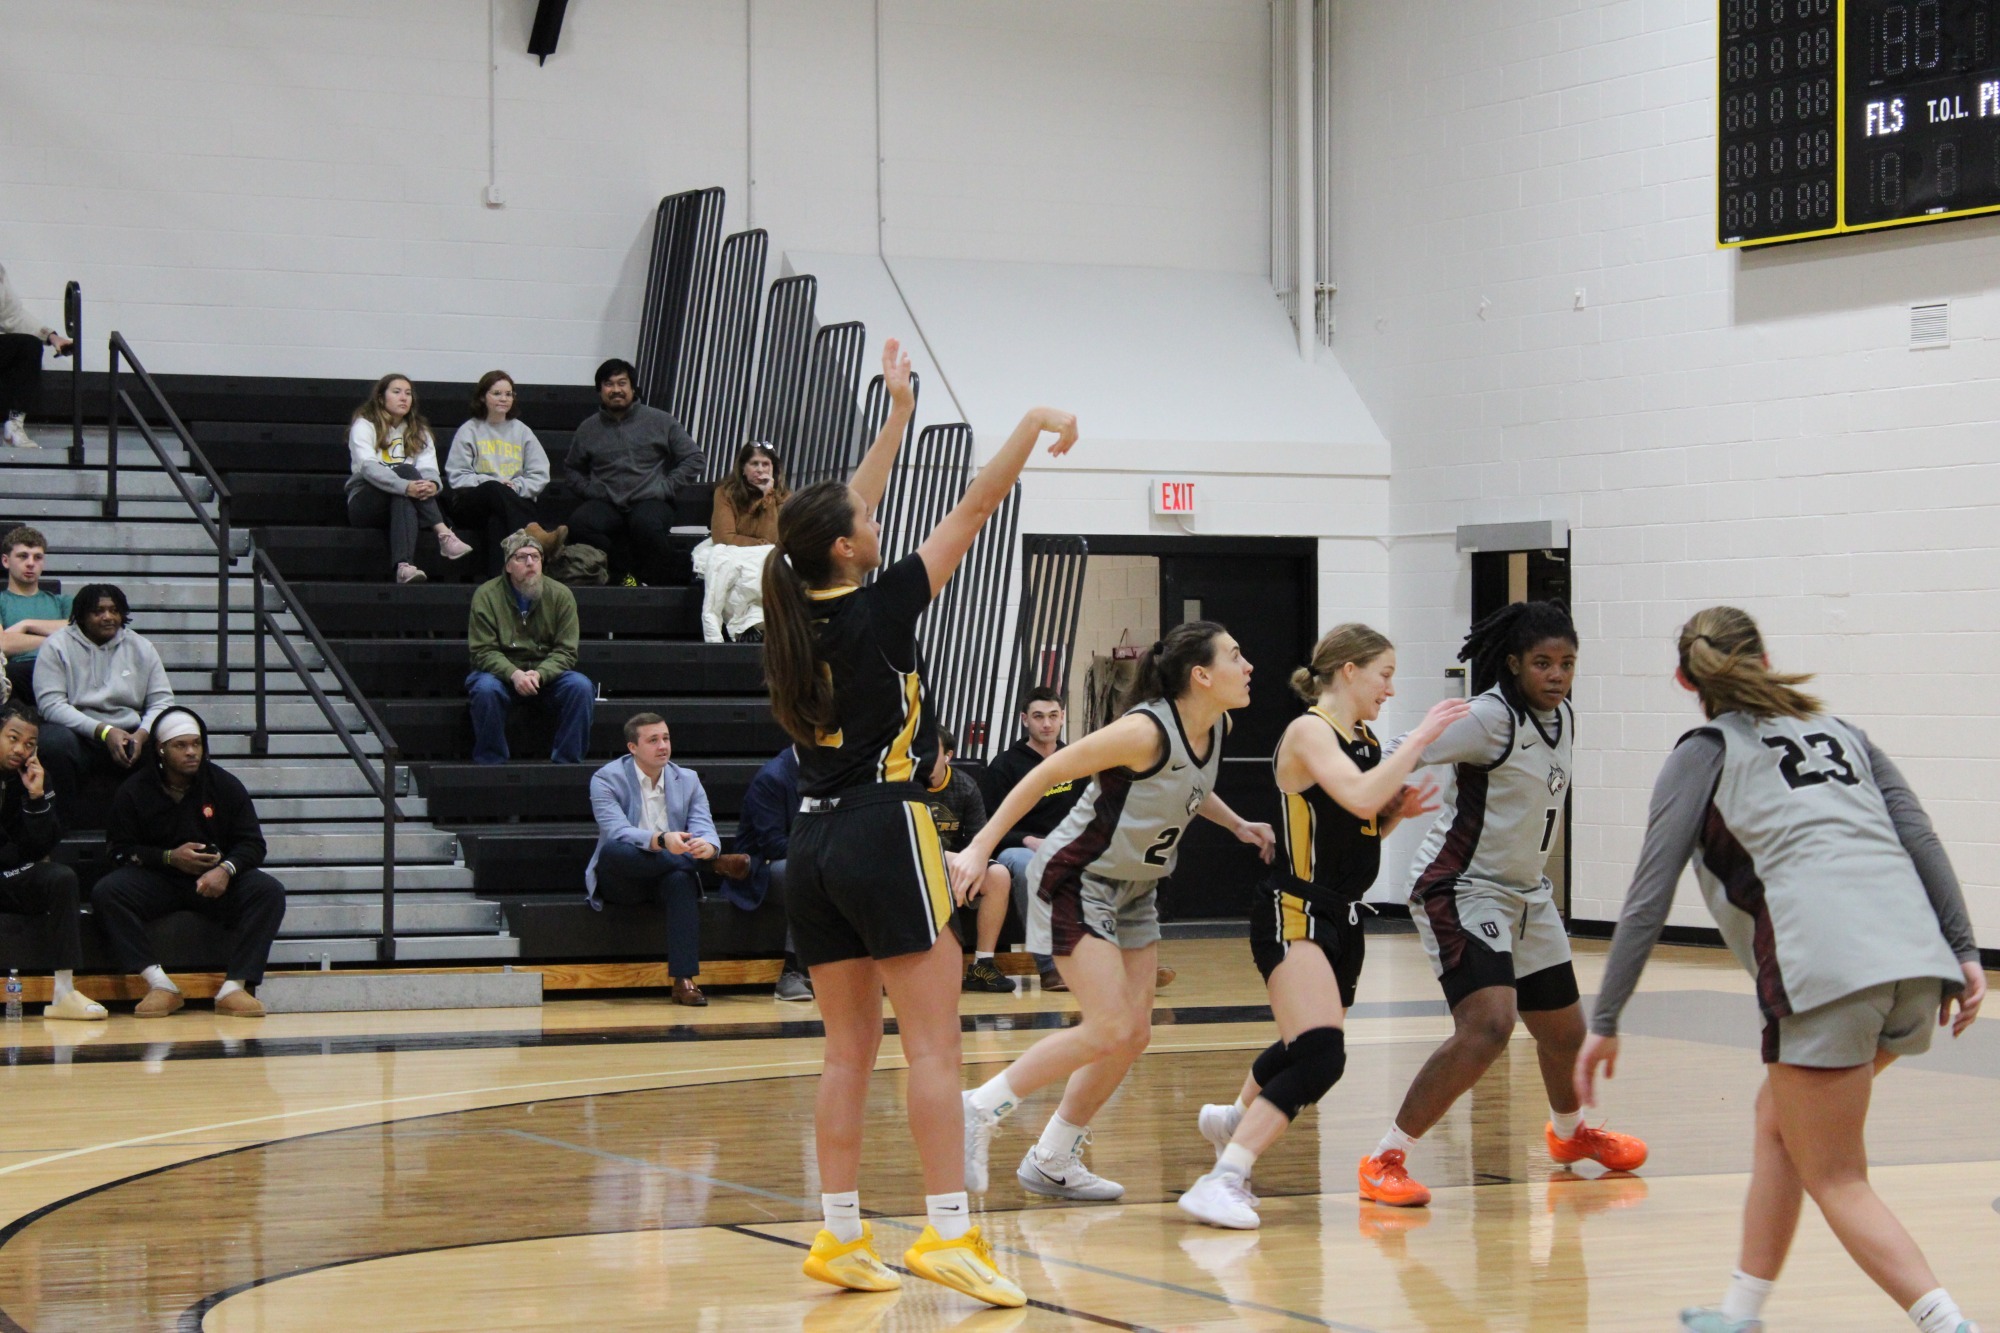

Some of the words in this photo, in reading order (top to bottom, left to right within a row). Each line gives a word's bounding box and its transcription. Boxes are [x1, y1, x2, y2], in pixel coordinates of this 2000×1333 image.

[1866, 98, 1904, 136] FLS
[1927, 95, 1969, 123] T.O.L.
[1162, 482, 1194, 510] EXIT
[1760, 731, 1863, 792] 23
[1142, 825, 1182, 867] 2
[1538, 806, 1558, 854] 1
